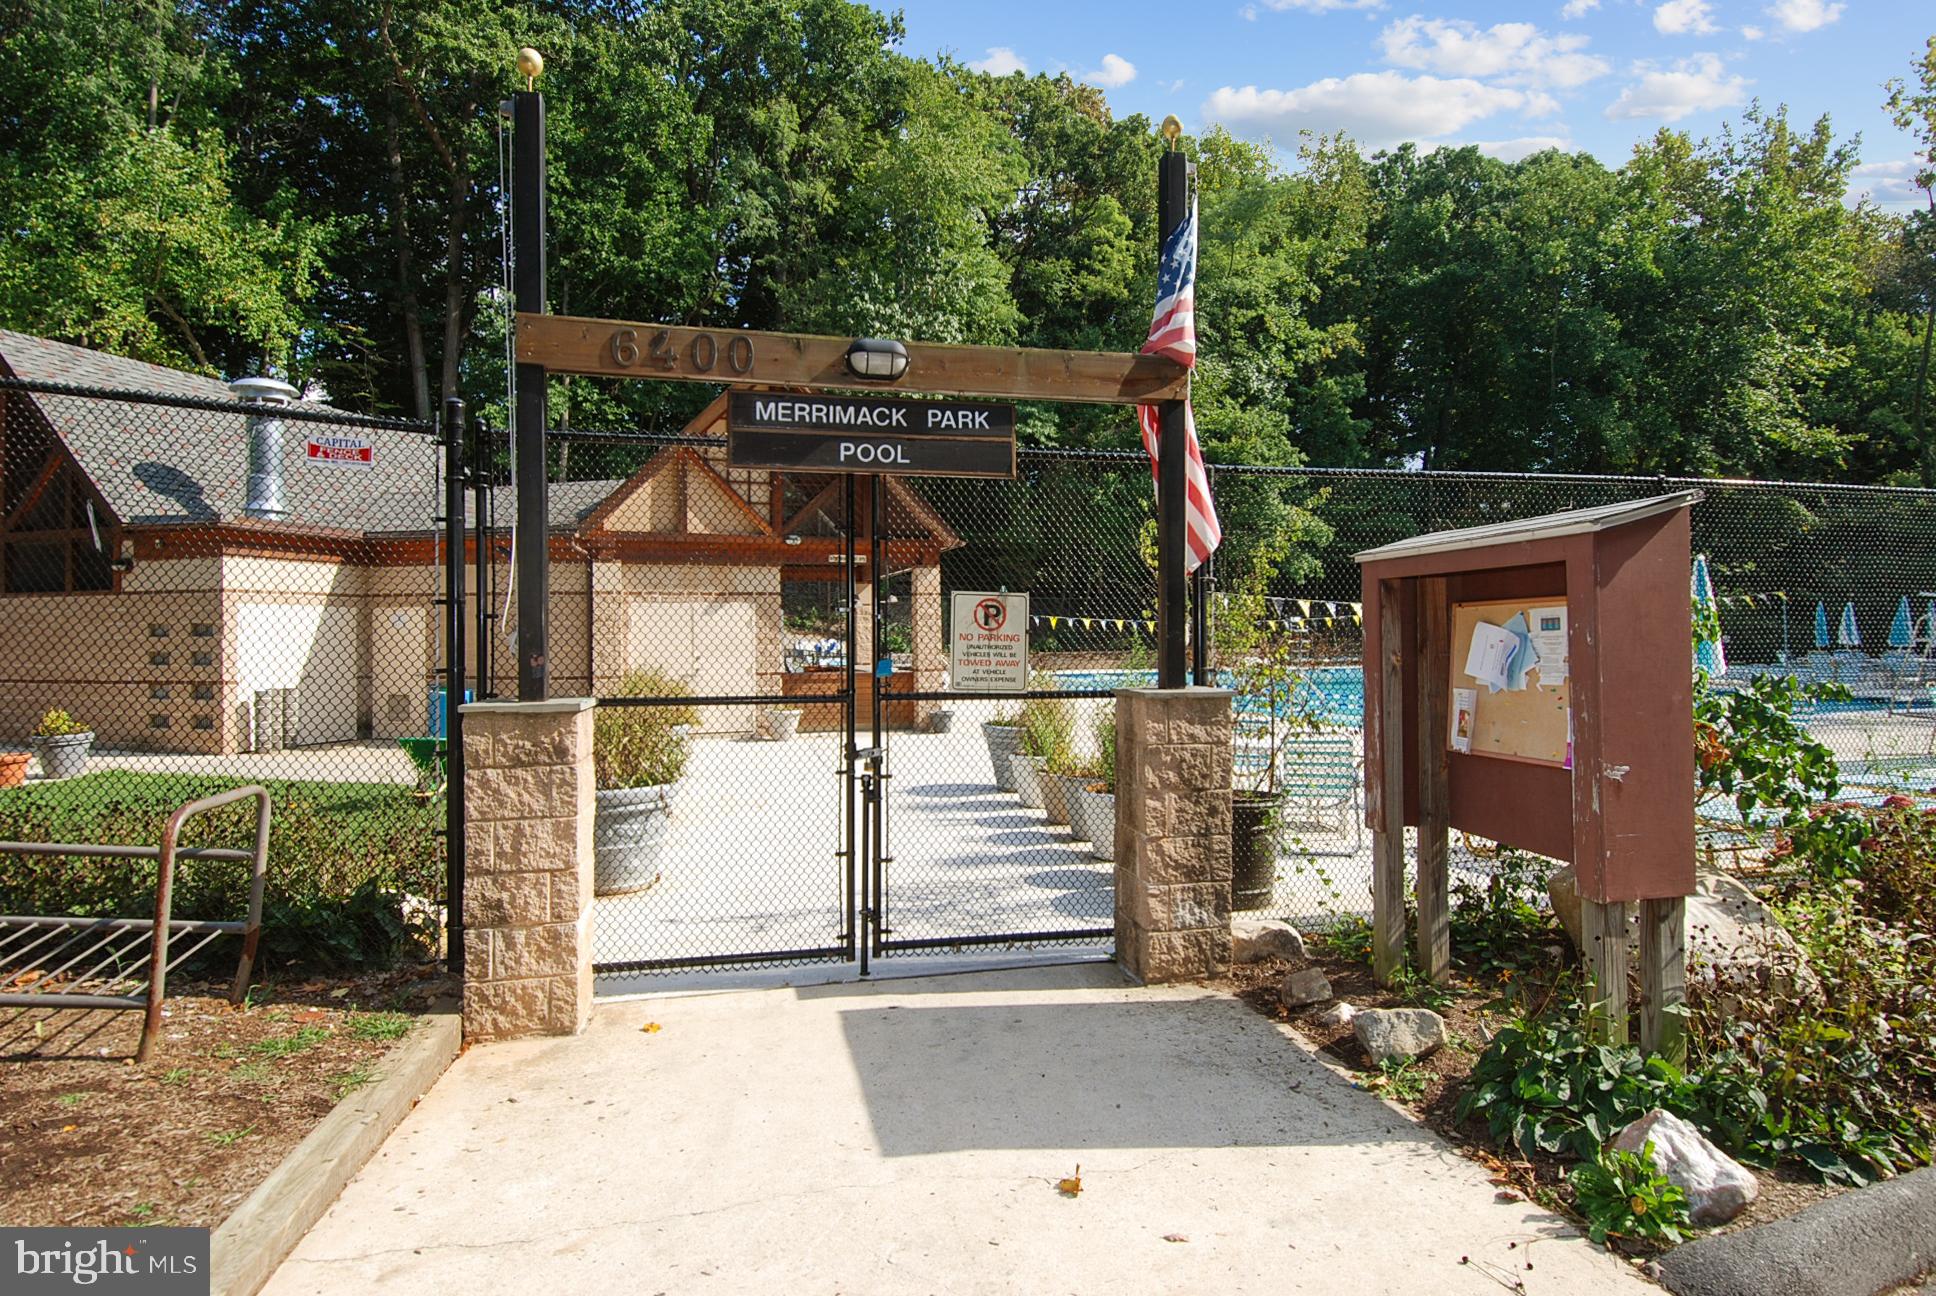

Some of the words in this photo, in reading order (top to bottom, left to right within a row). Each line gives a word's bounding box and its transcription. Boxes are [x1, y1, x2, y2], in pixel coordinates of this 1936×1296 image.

[611, 327, 755, 373] 6400
[755, 401, 908, 427] MERRIMACK
[927, 409, 990, 430] PARK
[316, 437, 364, 448] CAPITAL
[839, 442, 911, 464] POOL
[959, 633, 973, 641] NO
[978, 634, 1020, 642] PARKING
[959, 659, 992, 667] TOWED
